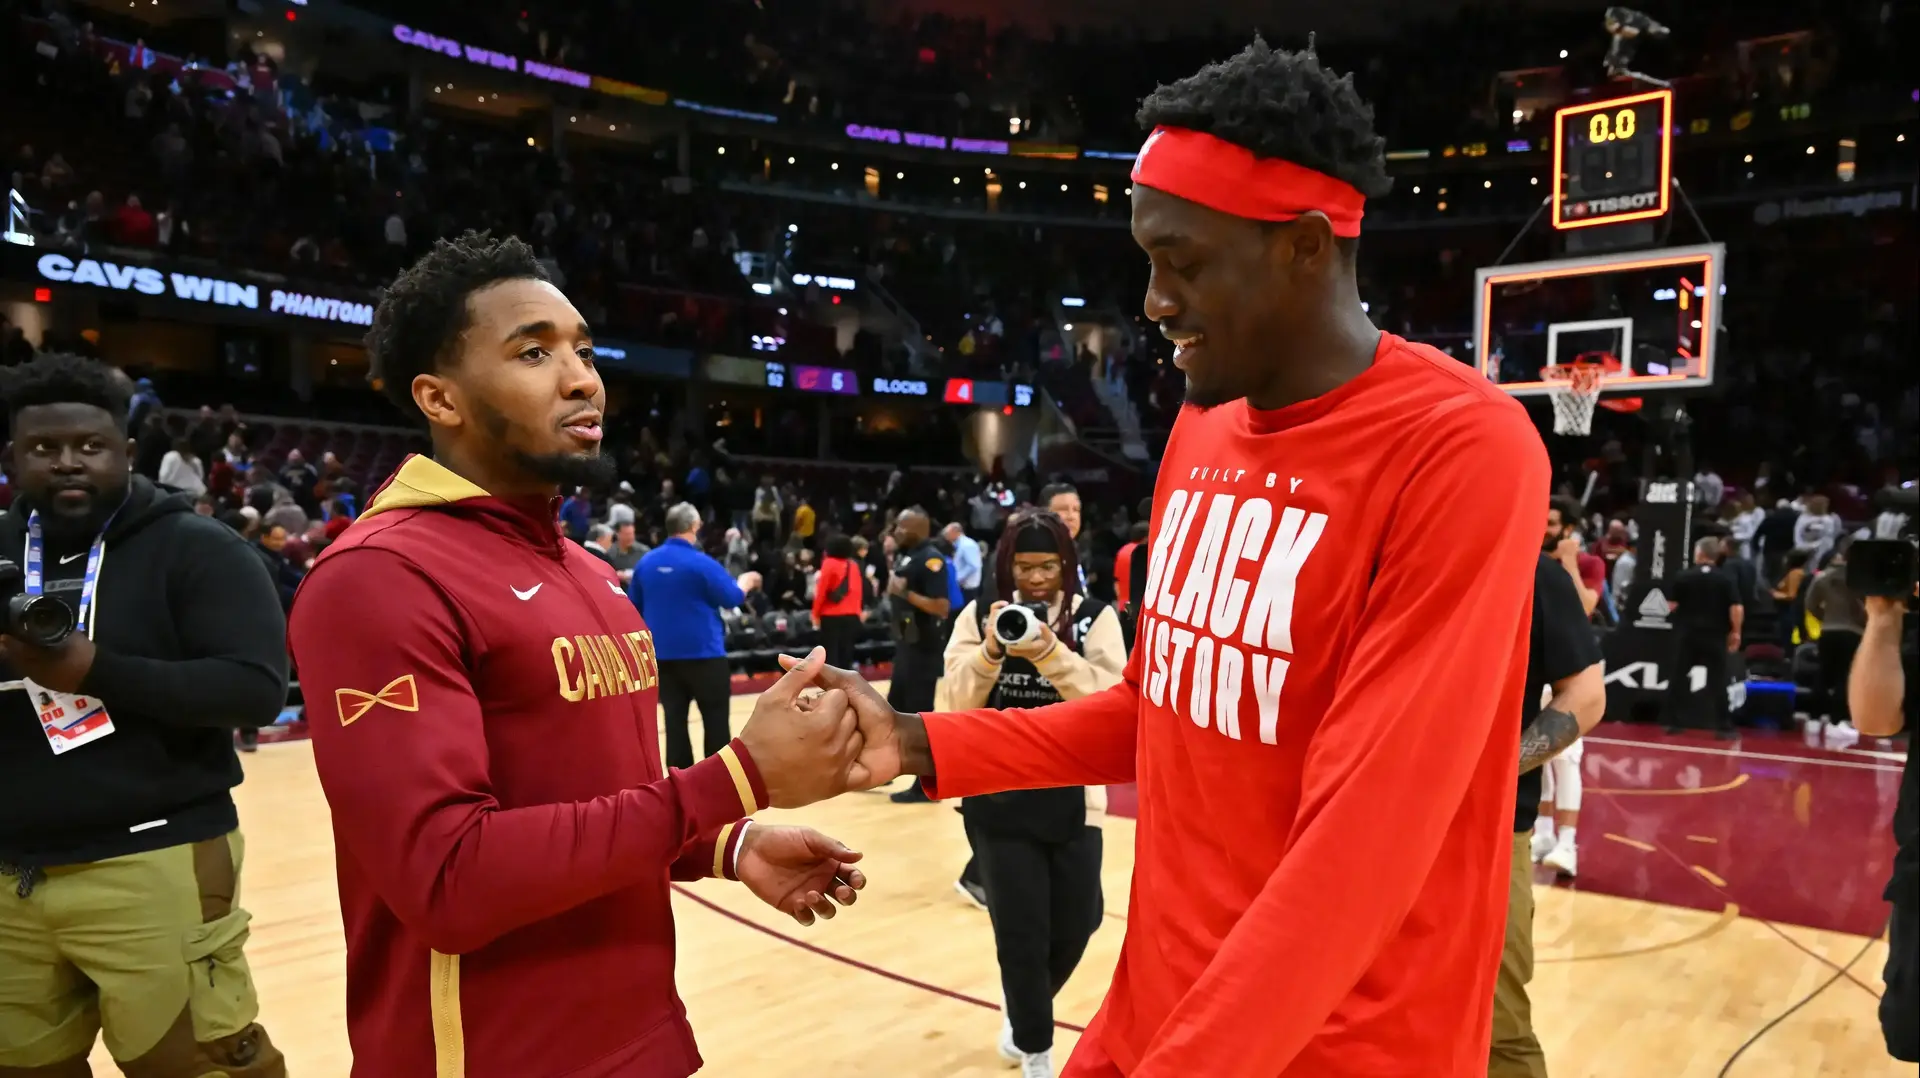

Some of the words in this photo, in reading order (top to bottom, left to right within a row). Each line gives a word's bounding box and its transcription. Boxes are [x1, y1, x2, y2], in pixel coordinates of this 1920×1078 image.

[393, 24, 461, 57] CAVS
[462, 45, 517, 72] WIN
[846, 123, 900, 144] CAVS
[904, 130, 947, 149] WIN
[1589, 109, 1635, 143] 0.0
[1589, 192, 1658, 213] TISSOT
[37, 253, 165, 295] CAVS
[170, 272, 258, 309] WIN
[270, 289, 373, 326] PHANTOM
[873, 378, 928, 396] BLOCKS
[957, 384, 970, 401] 4
[1189, 467, 1245, 482] BUILT
[1265, 472, 1304, 494] BY
[1144, 489, 1328, 654] BLACK
[551, 629, 658, 702] CAVALIE
[1142, 614, 1291, 746] ISTORY
